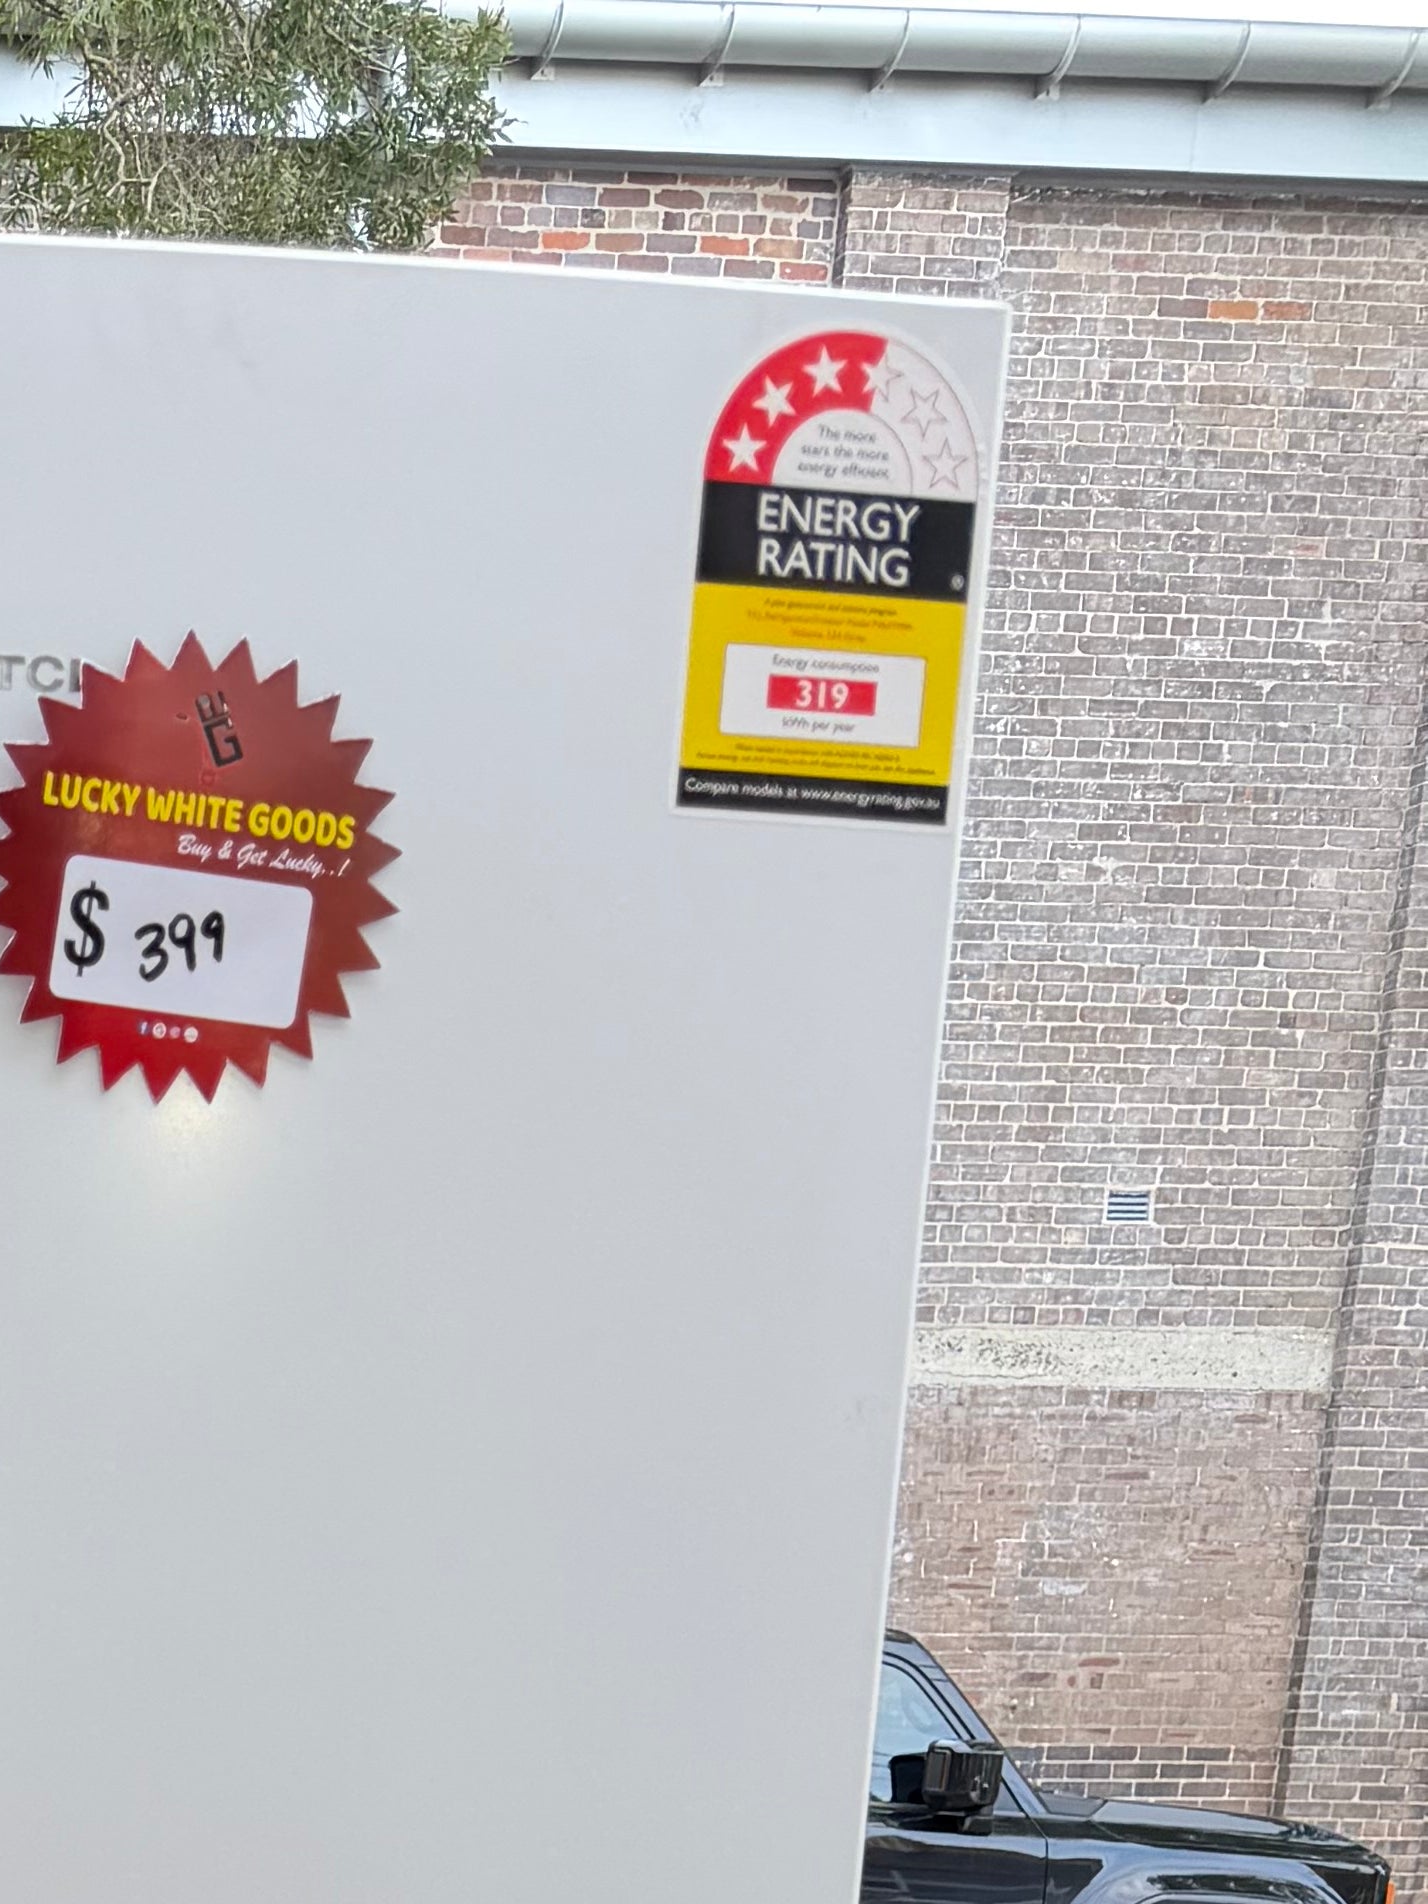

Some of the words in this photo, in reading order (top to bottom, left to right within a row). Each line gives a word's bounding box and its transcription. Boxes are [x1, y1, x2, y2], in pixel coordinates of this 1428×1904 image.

[756, 492, 921, 545] ENERGY
[757, 539, 911, 587] RATING
[772, 653, 809, 671] Energy
[795, 679, 850, 710] 319
[684, 777, 740, 797] Compare
[742, 783, 785, 799] models
[43, 770, 142, 818] LUCKY
[146, 786, 244, 833] WHITE
[248, 802, 357, 850] GOODS
[177, 833, 213, 863] Buy
[217, 838, 234, 860] &
[236, 842, 266, 869] Get
[63, 880, 111, 977] $
[134, 910, 226, 983] 399
